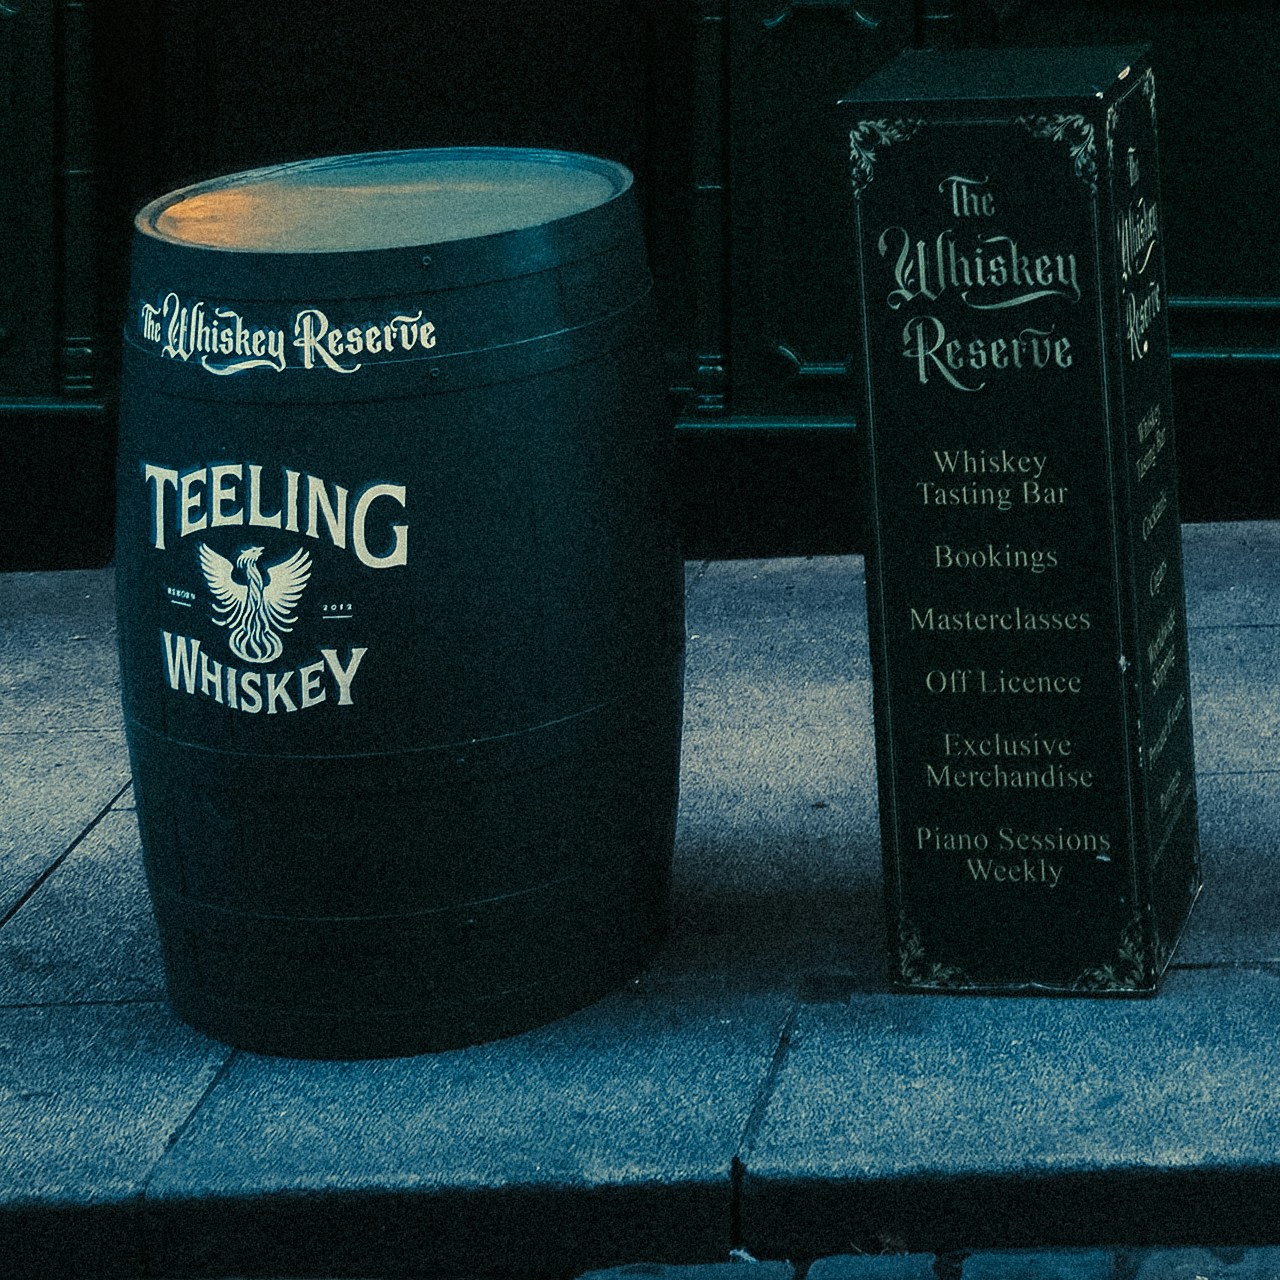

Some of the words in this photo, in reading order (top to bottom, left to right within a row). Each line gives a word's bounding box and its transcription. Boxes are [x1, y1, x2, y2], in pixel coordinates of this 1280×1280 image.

[938, 175, 996, 218] The
[878, 226, 1081, 310] Whiskey
[141, 303, 162, 343] The
[161, 292, 286, 376] Whiskey
[293, 308, 437, 374] Reserve
[902, 315, 1073, 391] Reserve
[933, 450, 1048, 478] Whiskey
[916, 482, 1012, 511] Tasting
[1023, 481, 1069, 506] Bar
[144, 463, 409, 568] TEELING
[934, 544, 1059, 574] Bookings
[910, 606, 1091, 632] Masterclasses
[162, 630, 369, 715] WHISKEY
[925, 669, 972, 694] Off
[980, 669, 1083, 694] Licence
[944, 732, 1072, 758] Exclusive
[926, 763, 1094, 789] Merchandise
[916, 827, 989, 852] Piano
[998, 827, 1112, 853] Sessions
[966, 858, 1065, 889] Weekly
